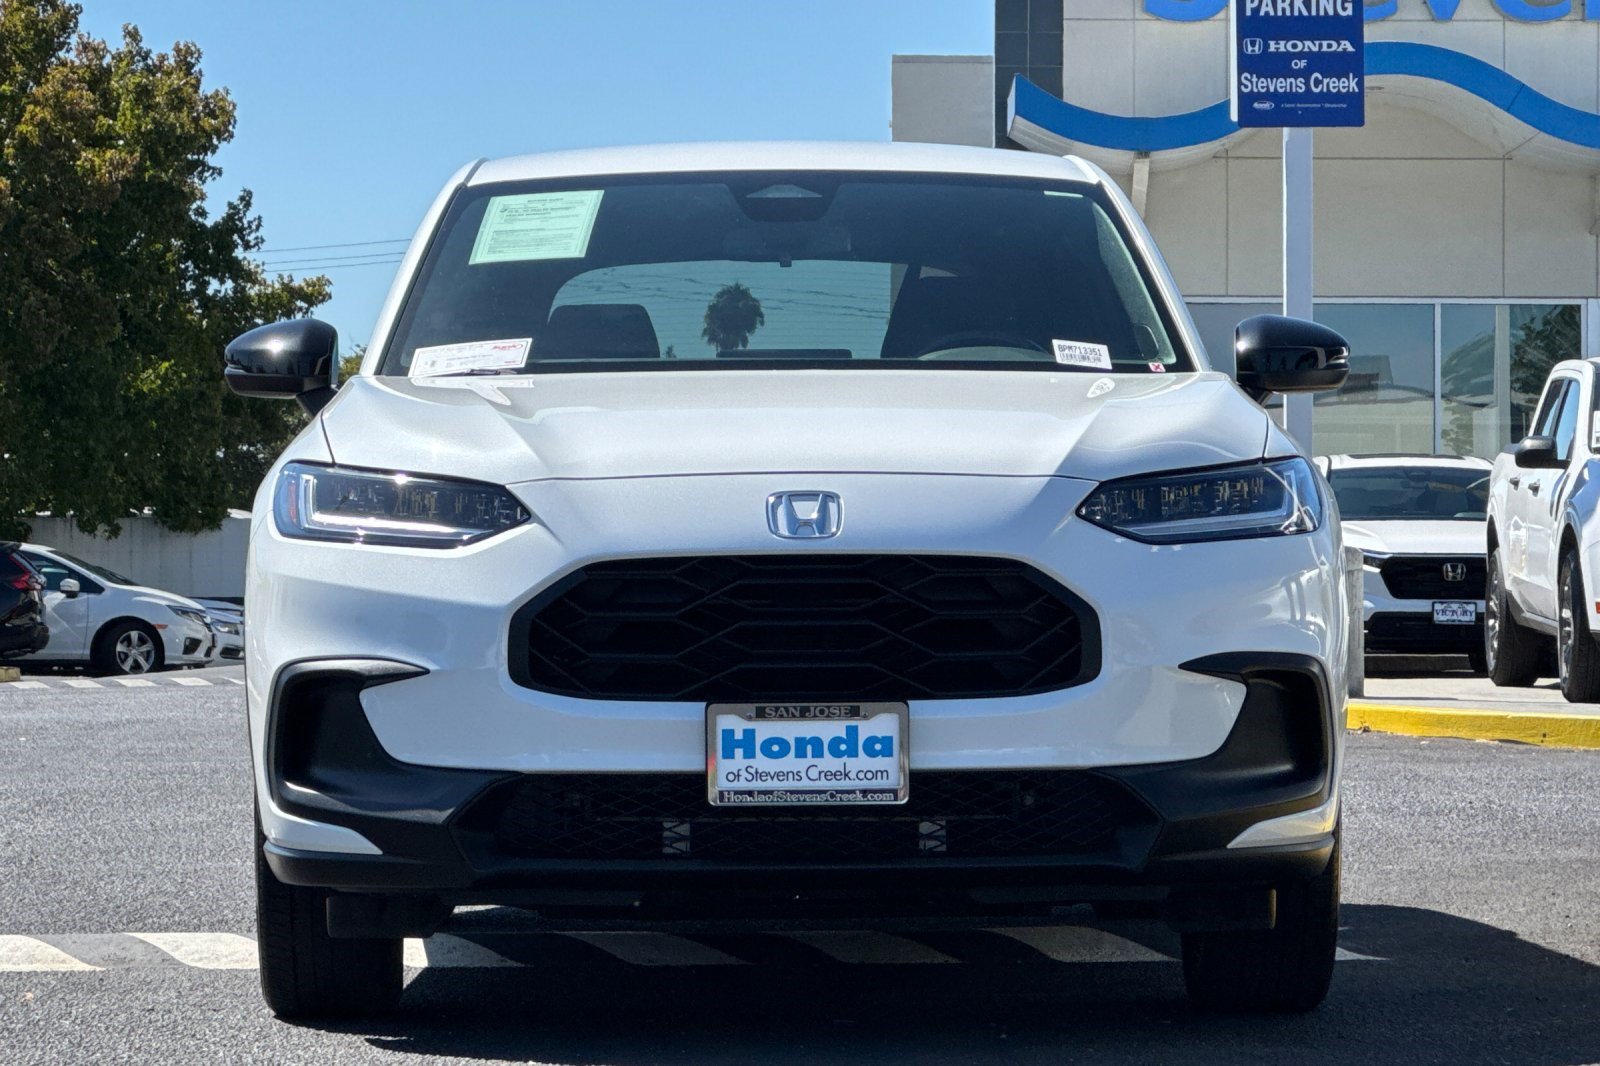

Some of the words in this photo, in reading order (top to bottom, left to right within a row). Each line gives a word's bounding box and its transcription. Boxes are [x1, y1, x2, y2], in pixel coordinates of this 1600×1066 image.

[1245, 0, 1353, 16] PARKING
[1268, 40, 1356, 52] HONDA
[1291, 59, 1308, 69] OF
[1240, 72, 1306, 93] Stevens
[1310, 72, 1359, 93] Creek
[1435, 609, 1474, 617] VICTORY
[764, 706, 800, 718] SAN
[805, 705, 852, 718] JOSE
[721, 725, 894, 760] Honda
[725, 768, 742, 783] of
[744, 765, 803, 782] Stevens
[805, 762, 889, 782] Creek.com
